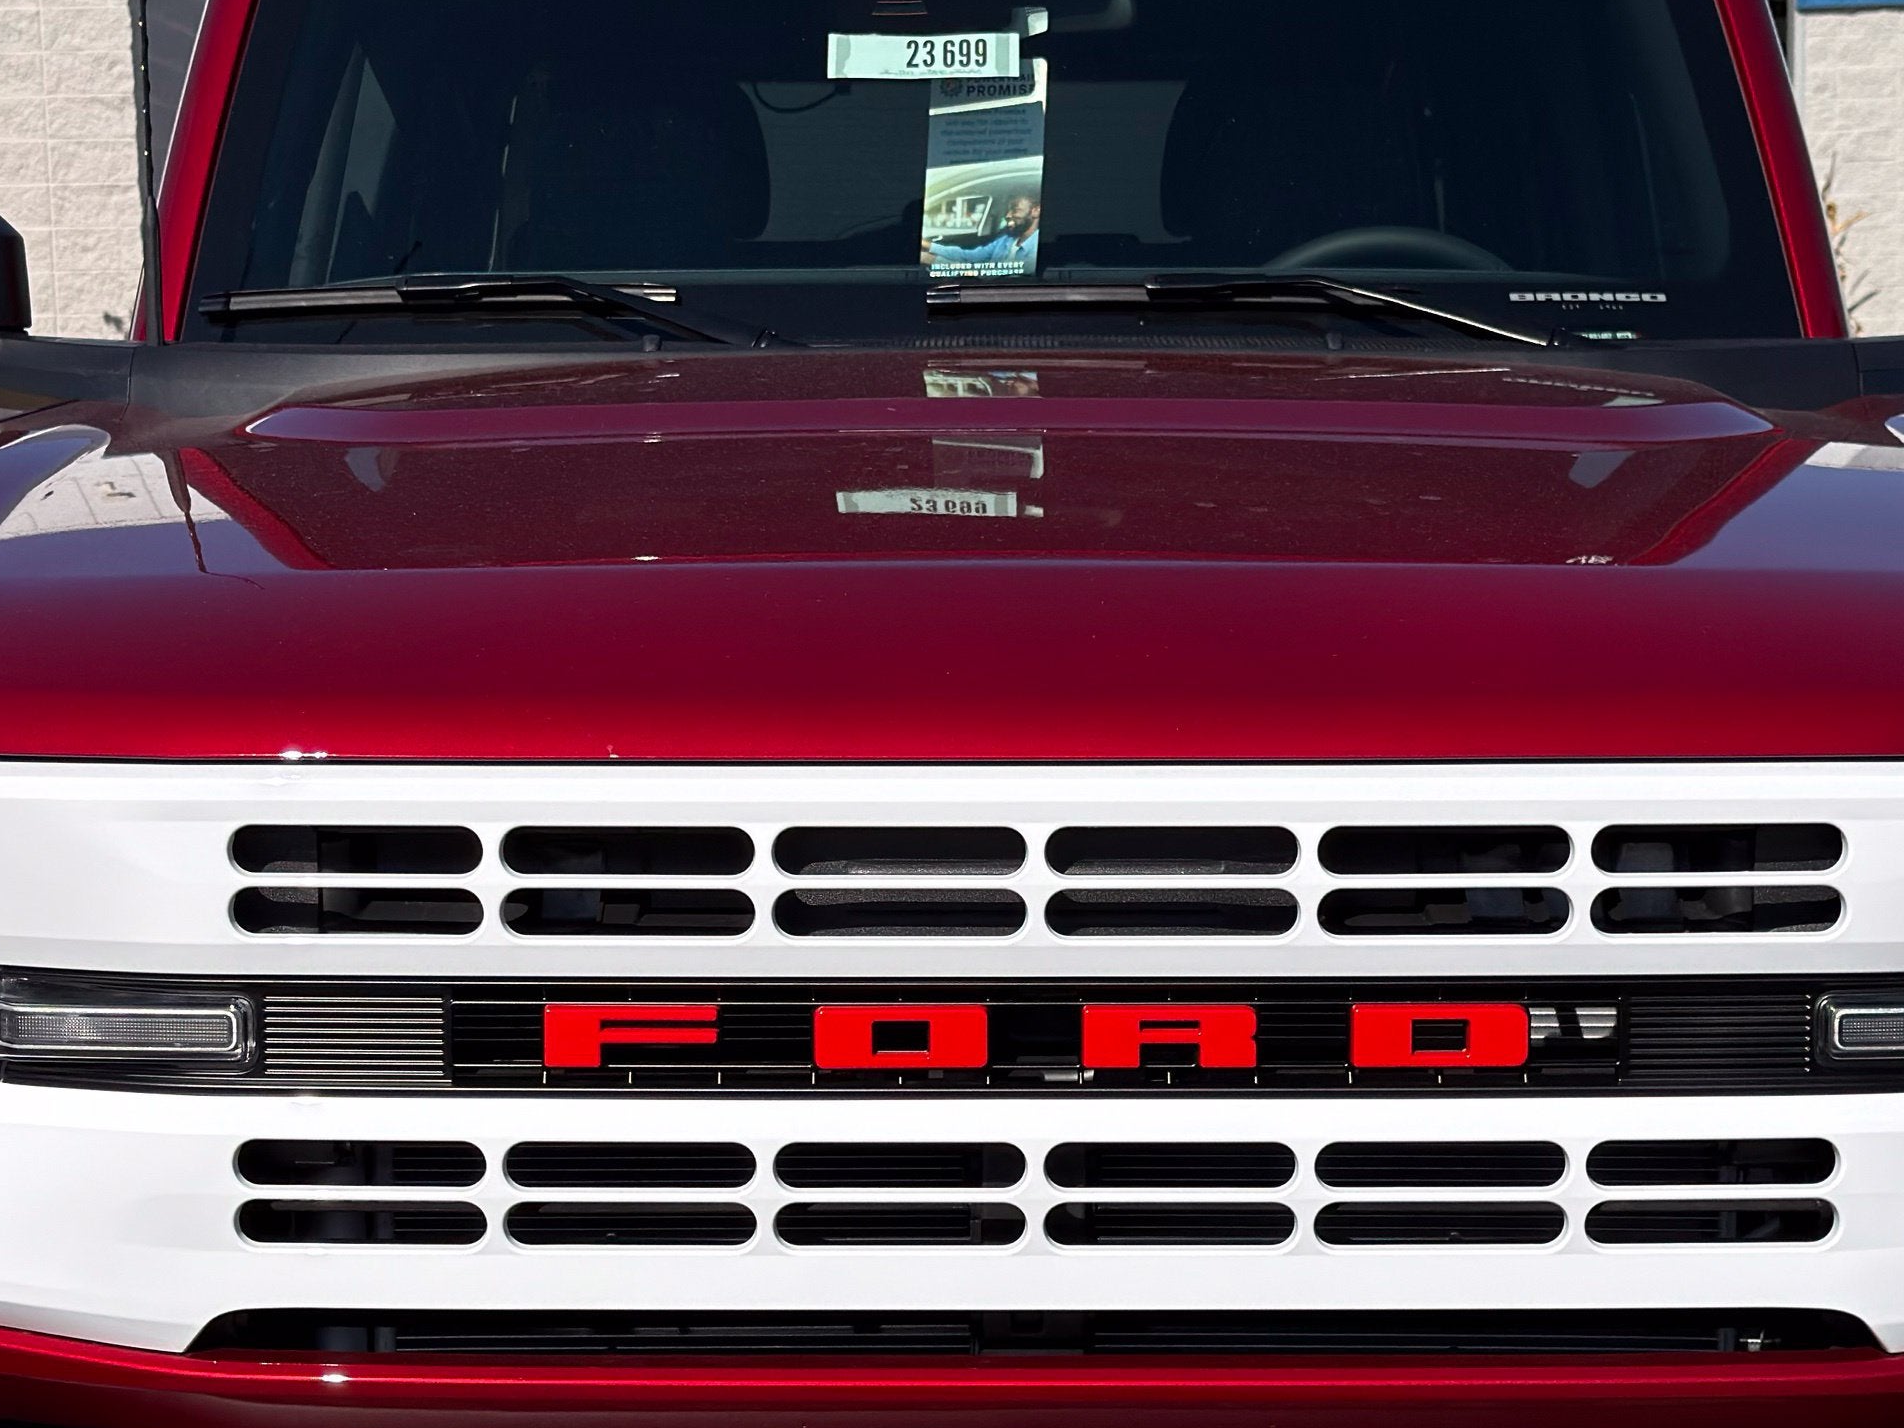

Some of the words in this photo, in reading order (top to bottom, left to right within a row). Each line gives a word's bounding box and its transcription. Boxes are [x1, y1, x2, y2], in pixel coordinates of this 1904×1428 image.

[931, 262, 972, 270] INCLUDED
[997, 261, 1025, 269] EVERY
[929, 269, 979, 278] QUALIFYING
[1508, 292, 1667, 302] BRONCO
[544, 1003, 1529, 1069] FORD
